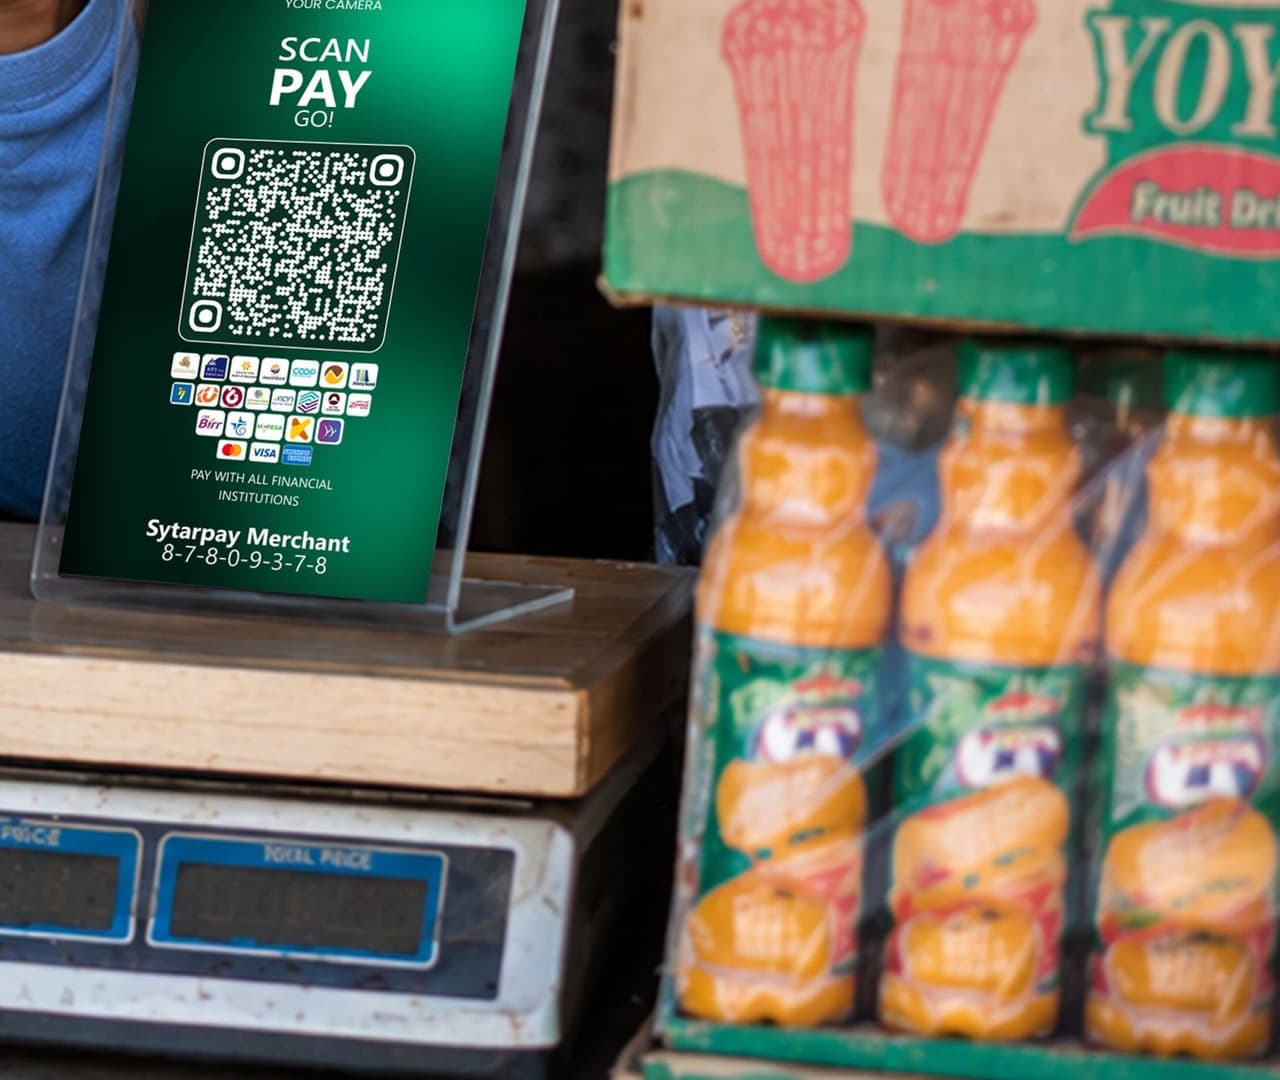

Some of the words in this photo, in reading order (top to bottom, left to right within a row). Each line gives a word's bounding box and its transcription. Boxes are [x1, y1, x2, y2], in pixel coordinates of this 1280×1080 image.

[324, 0, 383, 10] CAMERA
[278, 37, 371, 63] SCAN
[269, 68, 373, 109] PAY
[294, 109, 334, 128] GO!
[1130, 179, 1223, 228] Fruit
[198, 418, 223, 430] Birr
[254, 448, 276, 458] VISA
[190, 469, 212, 480] PAY
[214, 471, 245, 483] WITH
[247, 473, 268, 486] ALL
[271, 475, 333, 490] FINANCIAL
[218, 490, 300, 507] INSTITUTIONS
[146, 519, 241, 548] Sytarpay
[246, 527, 350, 553] Merchant
[161, 543, 327, 575] 8-7-8-0-9-3-7-8
